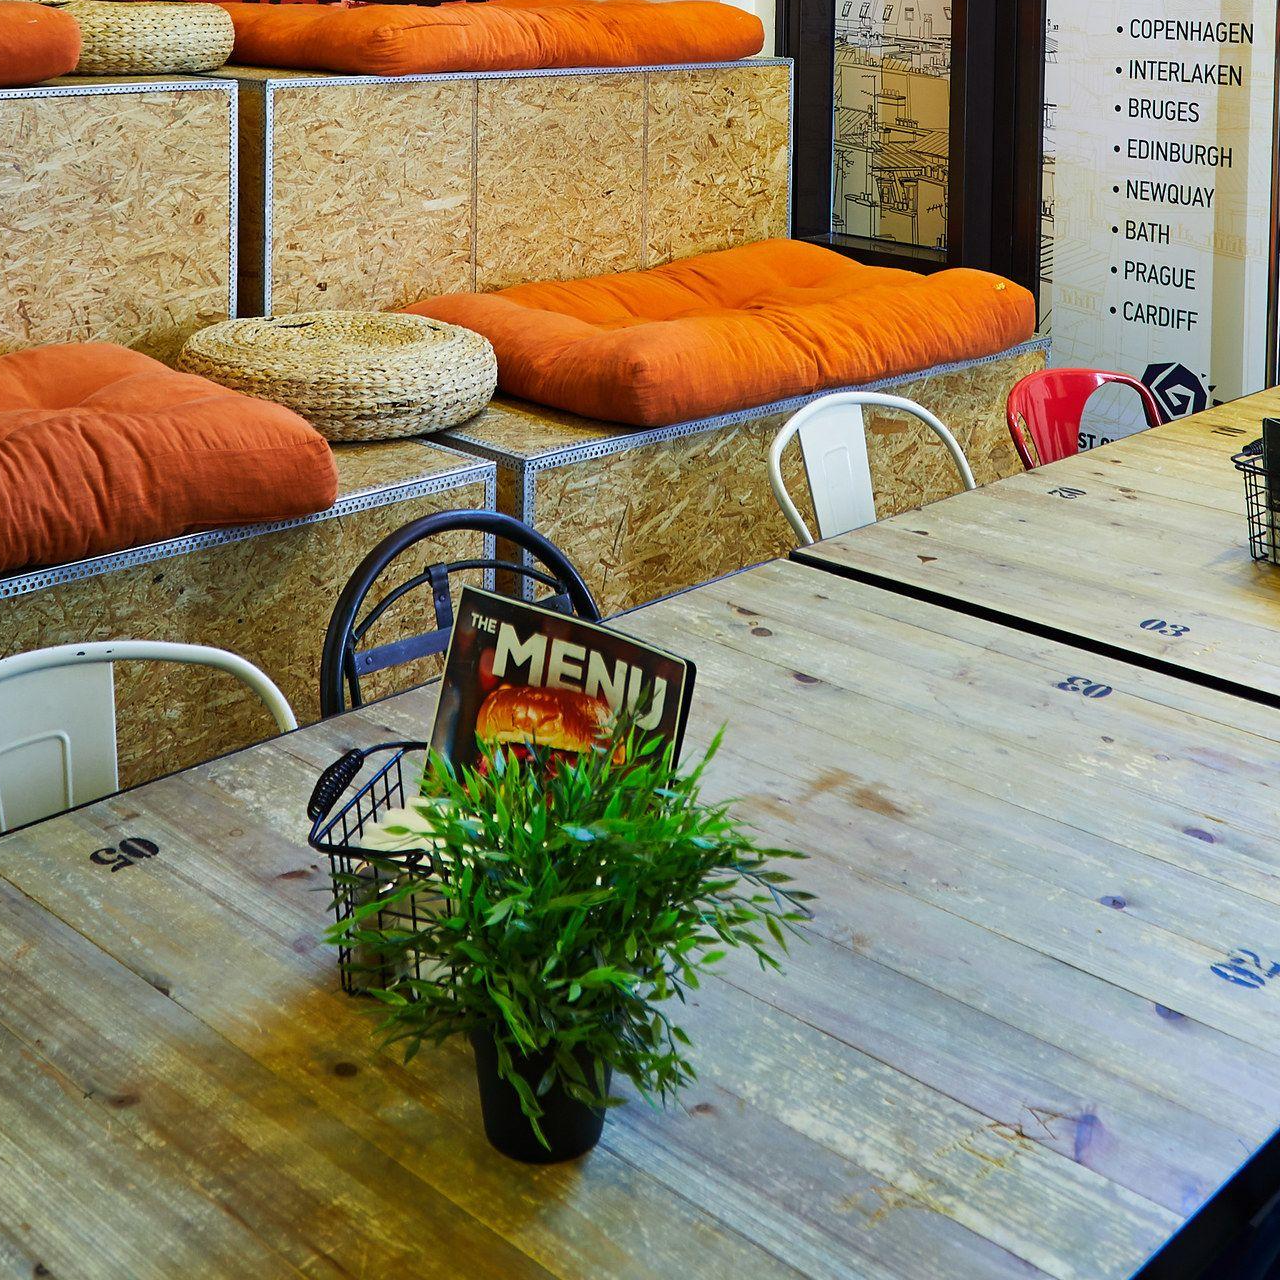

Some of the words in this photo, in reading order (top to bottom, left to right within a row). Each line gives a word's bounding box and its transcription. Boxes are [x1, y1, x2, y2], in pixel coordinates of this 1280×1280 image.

[1129, 19, 1254, 44] COPENHAGEN
[1129, 60, 1242, 86] INTERLAKEN
[1128, 98, 1200, 123] BRUGES
[1127, 139, 1233, 168] EDINBURGH
[1126, 179, 1215, 208] NEWQUAY
[1125, 220, 1171, 245] BATH
[1124, 260, 1197, 291] PRAGUE
[1123, 301, 1199, 332] CARDIFF
[470, 611, 498, 635] THE
[493, 622, 669, 732] MENU
